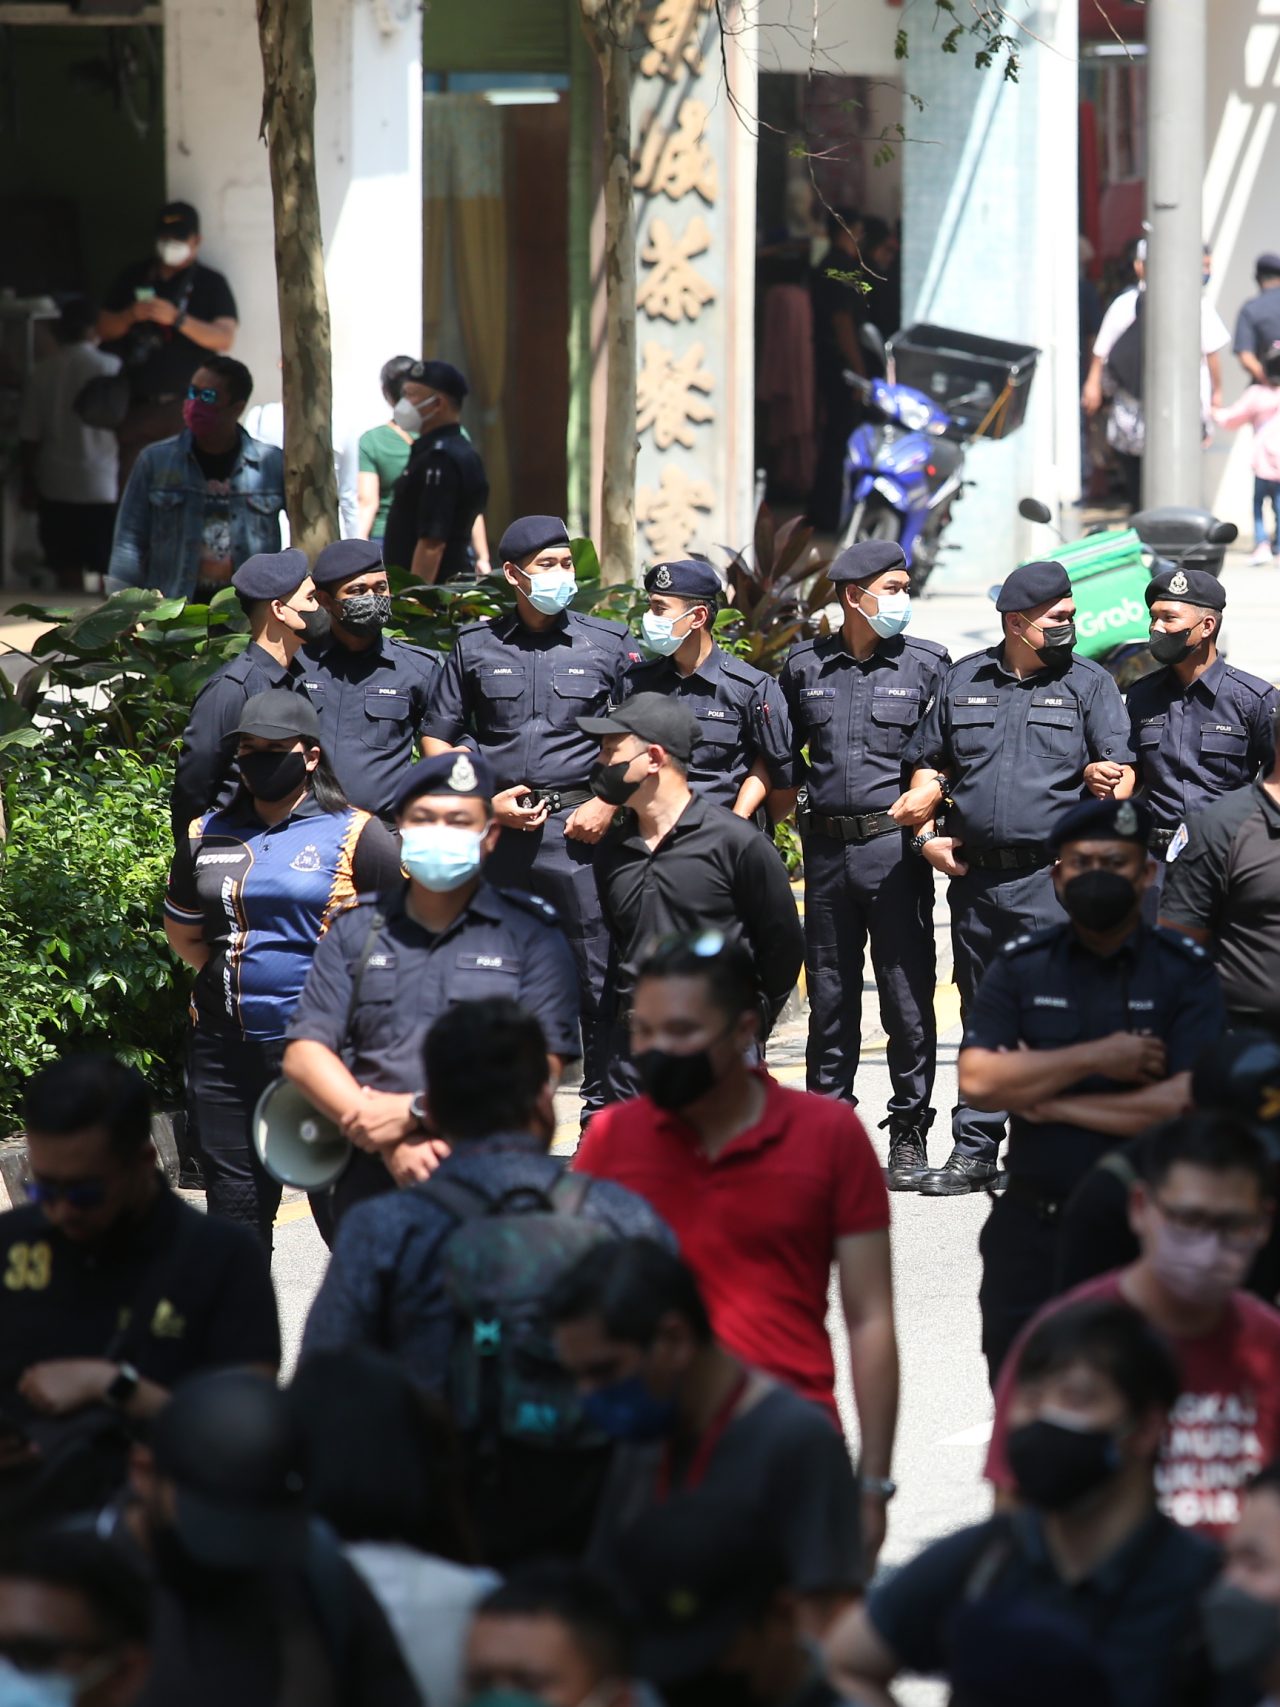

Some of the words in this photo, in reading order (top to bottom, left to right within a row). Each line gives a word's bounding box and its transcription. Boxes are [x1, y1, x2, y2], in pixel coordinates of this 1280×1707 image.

[1077, 597, 1144, 637] Grab
[379, 688, 397, 696] POLIS
[888, 689, 906, 697] POLIS
[221, 875, 236, 918] BIRU
[4, 1241, 52, 1290] 33
